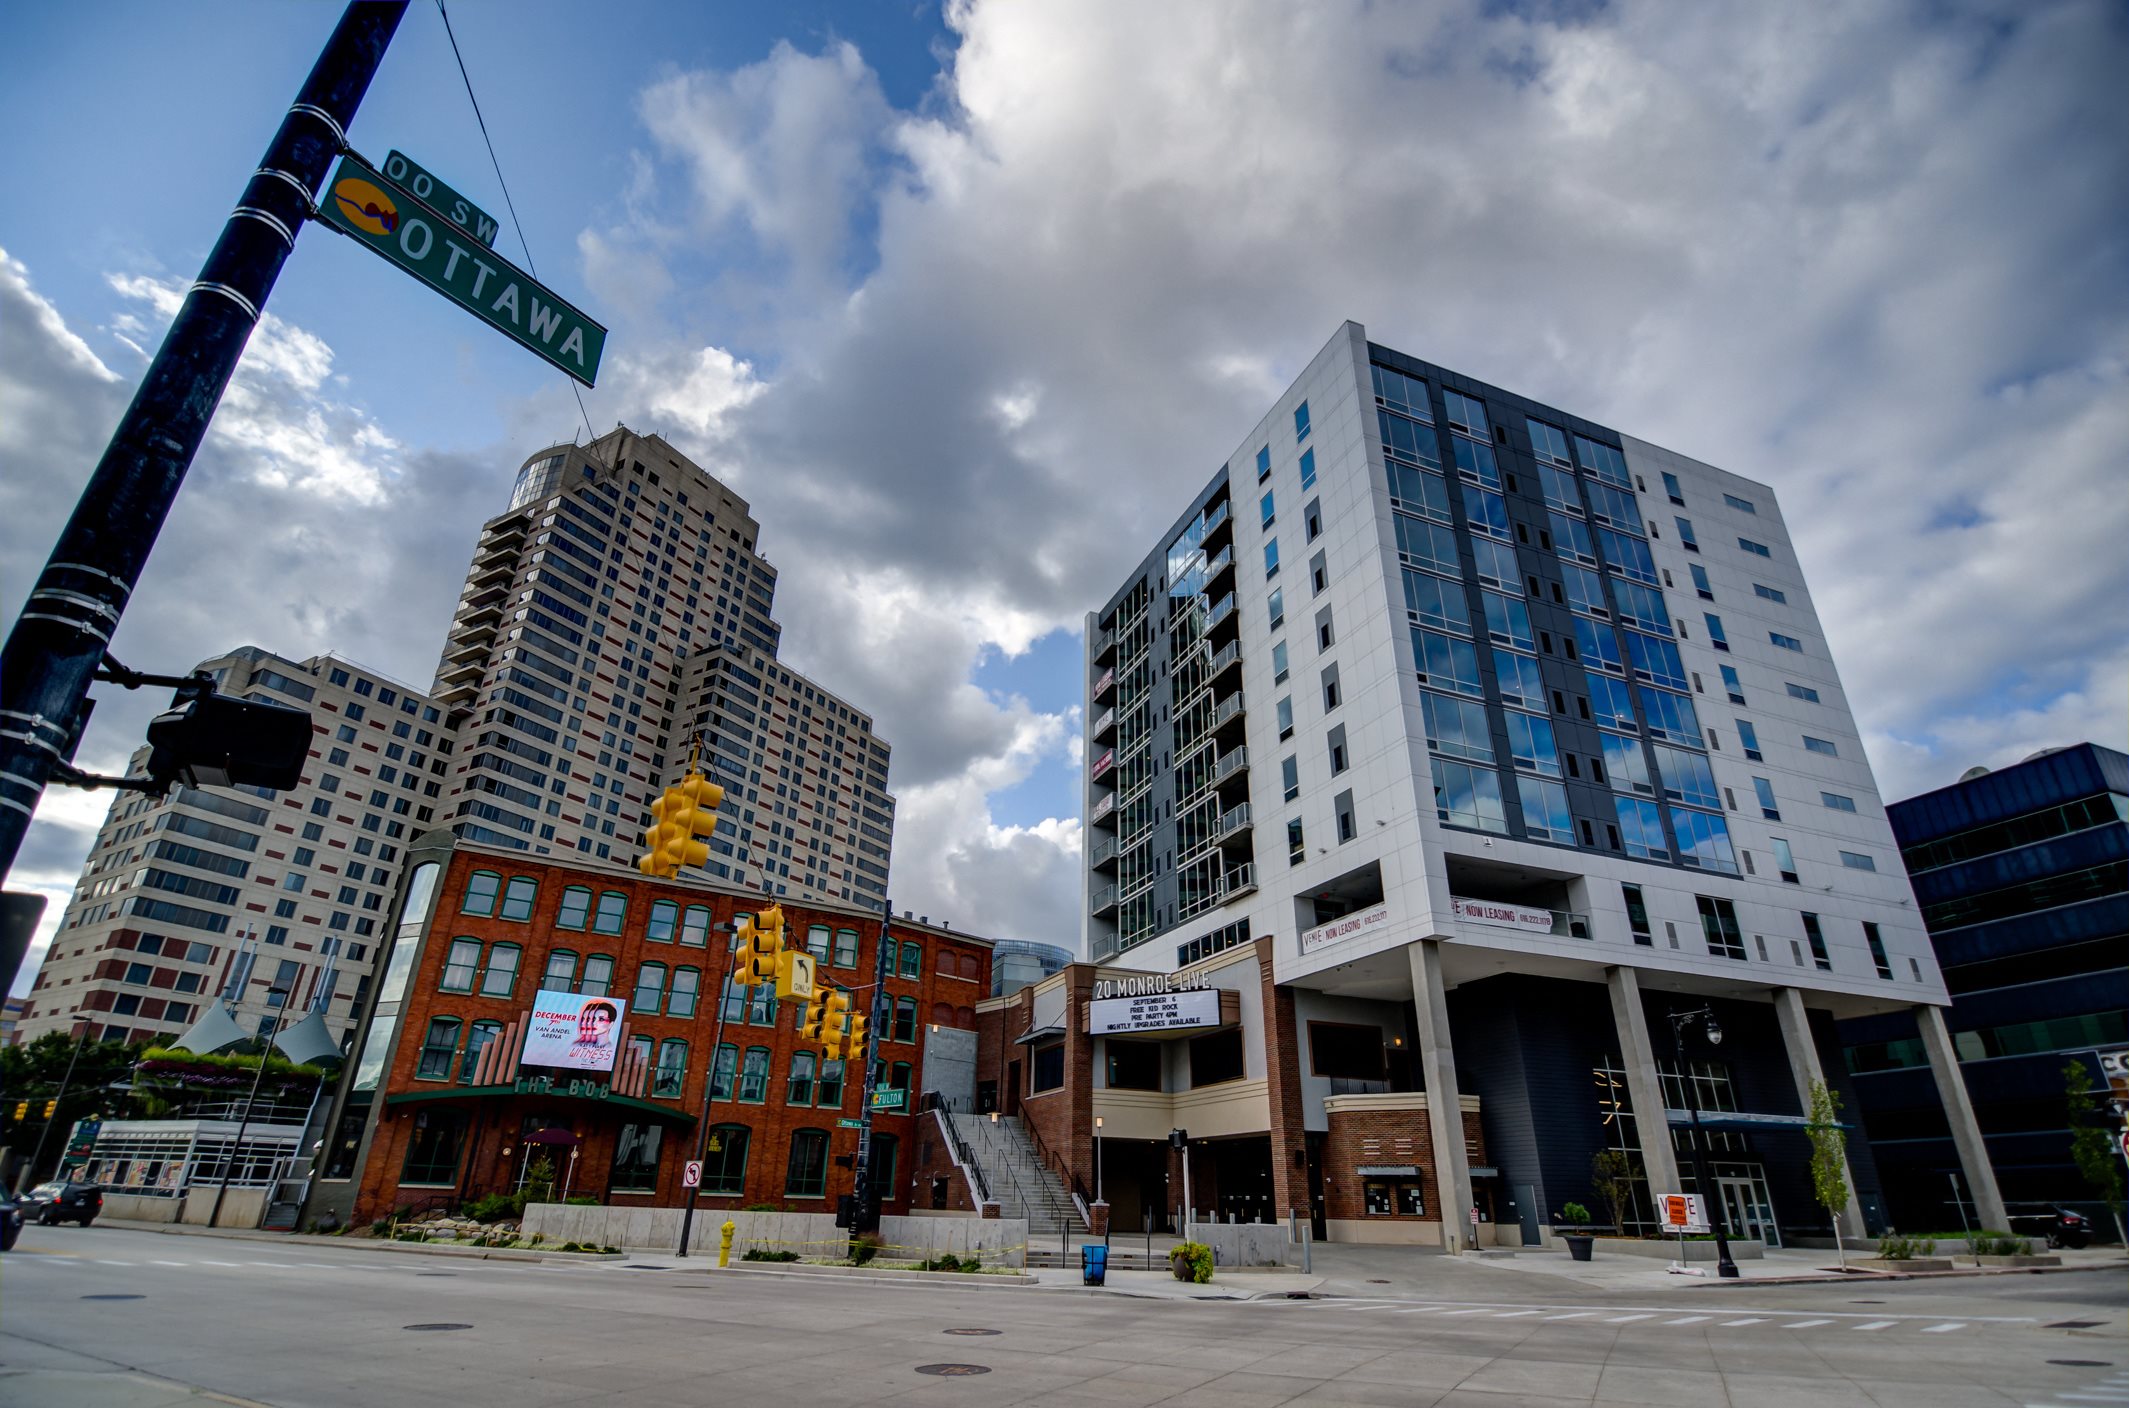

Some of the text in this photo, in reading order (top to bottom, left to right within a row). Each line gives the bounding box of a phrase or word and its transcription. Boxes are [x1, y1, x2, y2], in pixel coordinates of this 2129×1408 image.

[450, 200, 498, 244] SW
[399, 218, 585, 367] OTTAWA
[1465, 904, 1483, 918] NOW
[1484, 907, 1515, 922] LEASING
[1325, 927, 1338, 940] NOW
[1339, 918, 1361, 936] LEASING
[793, 982, 810, 994] ONLY
[1096, 970, 1210, 999] 20 MONROE LIVE
[1133, 996, 1167, 1006] SEPTEMBER
[1162, 1003, 1178, 1011] ROCK
[535, 1011, 577, 1022] DECEMBER
[1146, 1012, 1164, 1020] PARTY
[1134, 1019, 1166, 1029] UPGRADES
[1168, 1017, 1201, 1026] AVAILABLE
[569, 1047, 613, 1061] WITNESS
[514, 1076, 610, 1099] THE BOB
[878, 1092, 902, 1104] FULTON
